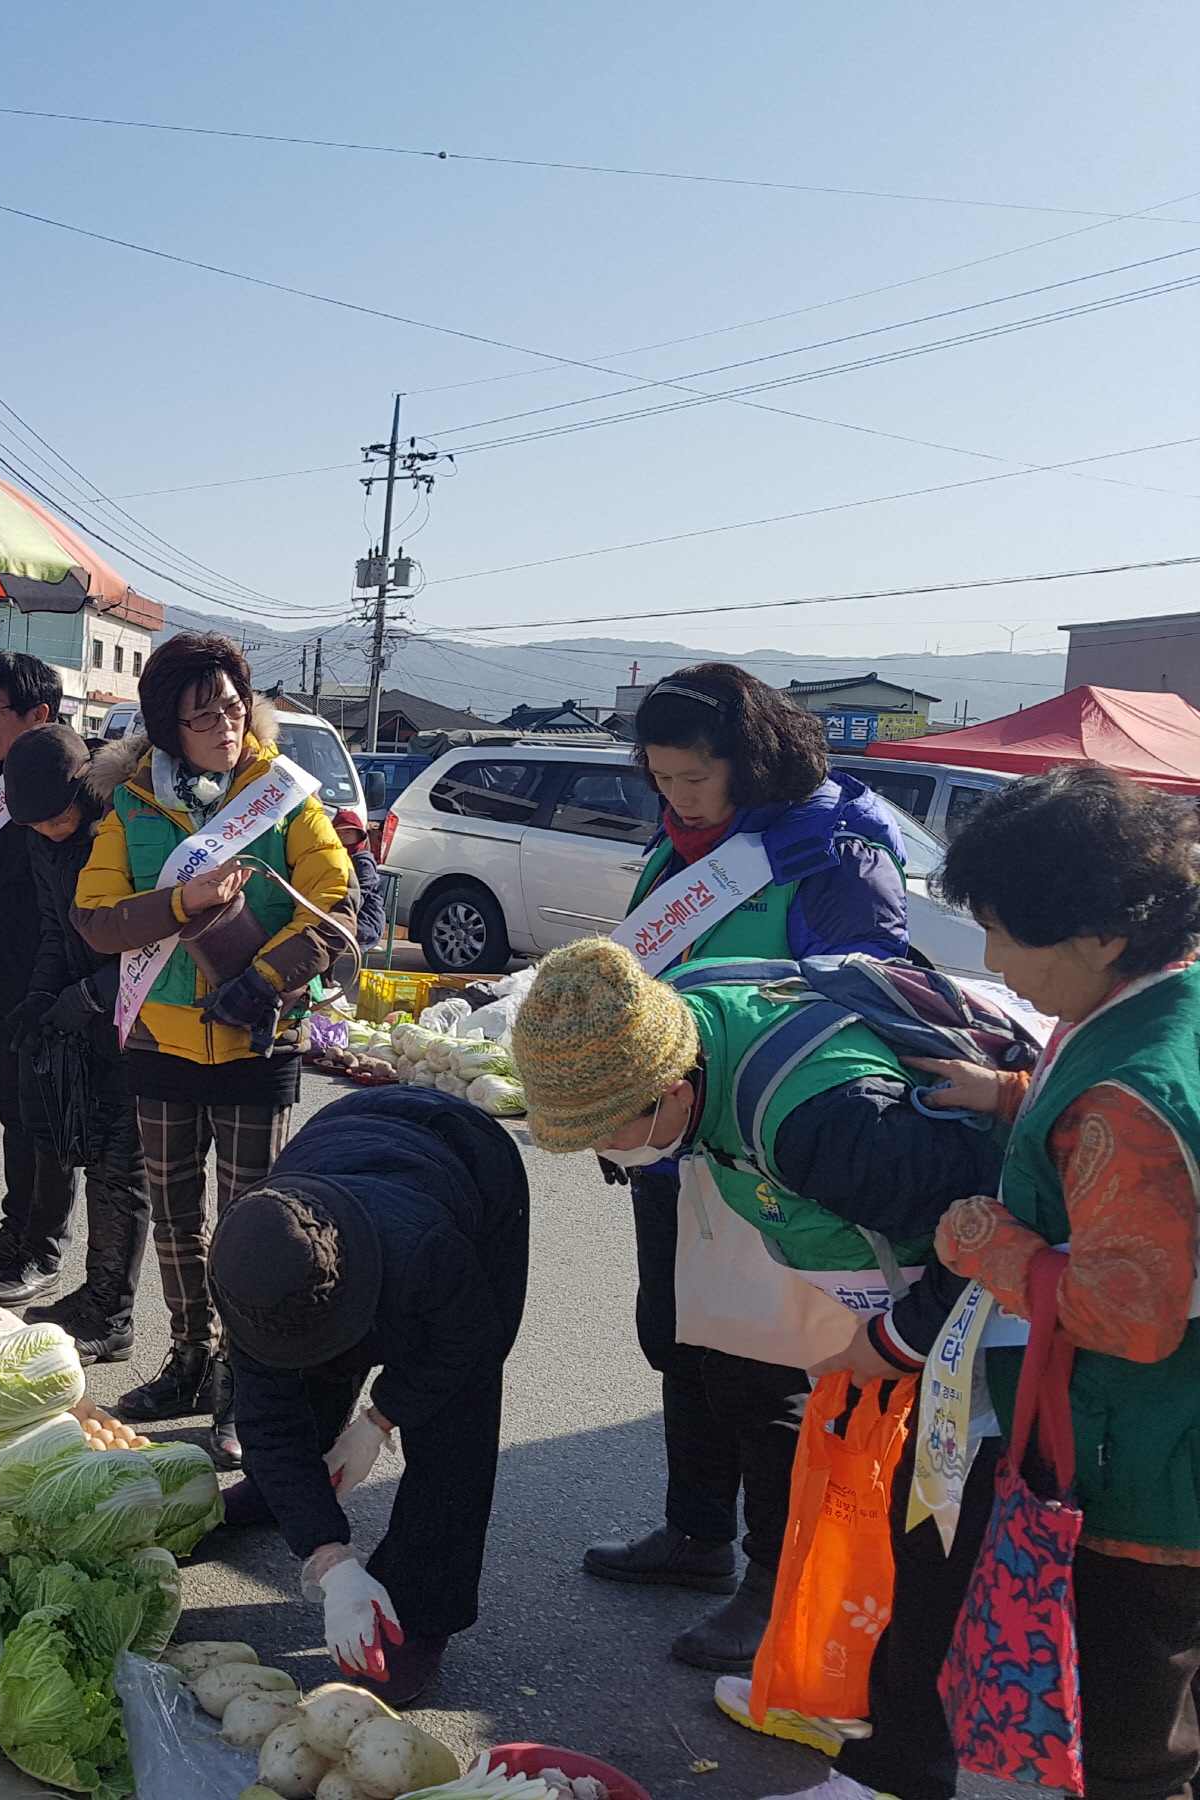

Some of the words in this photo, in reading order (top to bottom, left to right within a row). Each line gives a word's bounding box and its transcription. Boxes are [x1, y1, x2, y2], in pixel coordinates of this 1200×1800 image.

[826, 716, 869, 740] 철물
[222, 783, 286, 842] 전통시장
[707, 859, 729, 884] Golden
[635, 880, 716, 957] 전통시장
